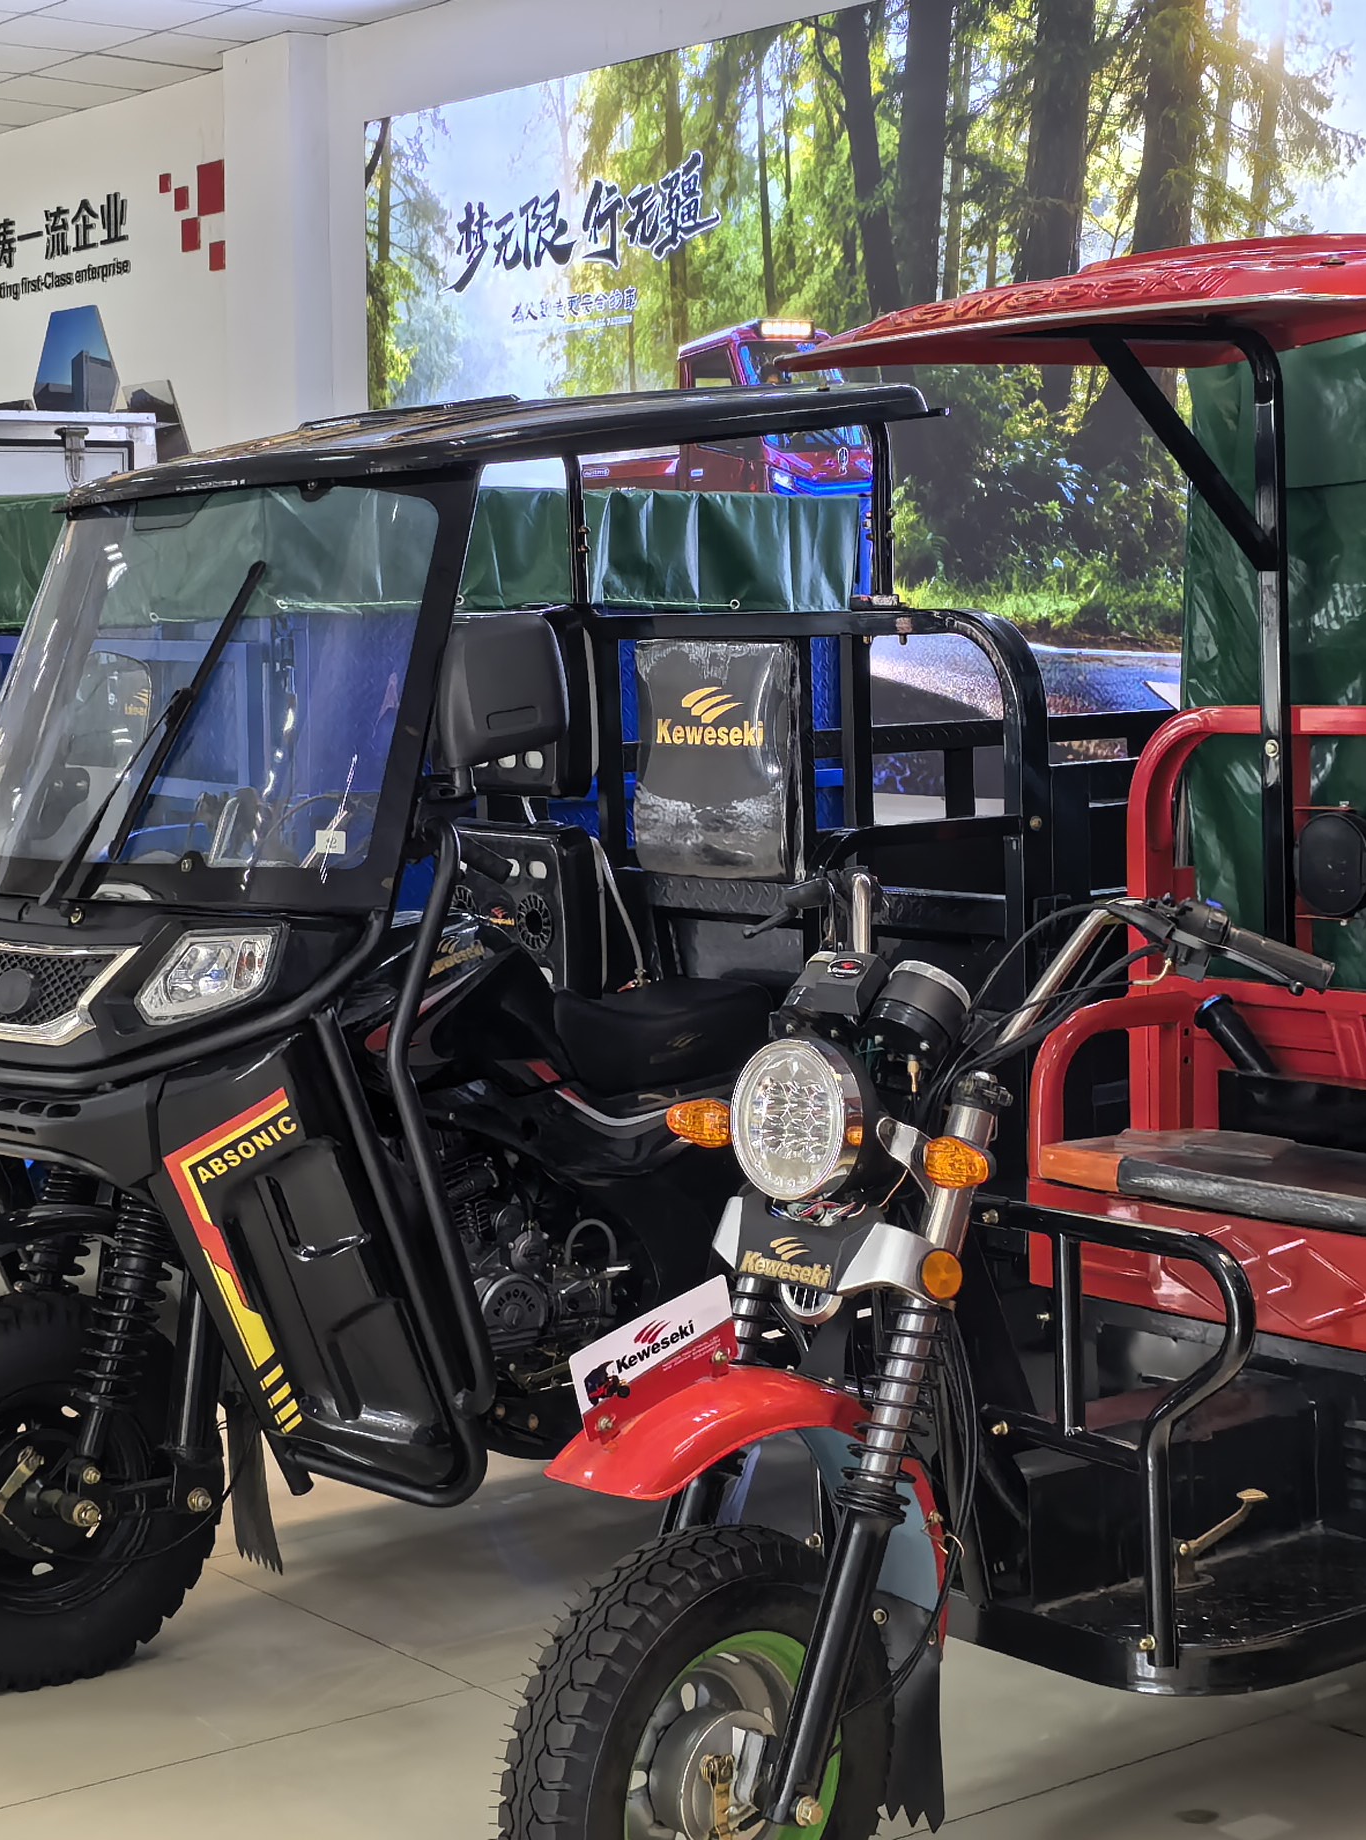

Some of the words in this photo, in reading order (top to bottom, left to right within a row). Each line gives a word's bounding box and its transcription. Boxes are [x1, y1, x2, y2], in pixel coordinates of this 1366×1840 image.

[439, 188, 578, 294] 梦无限
[74, 257, 132, 284] enterprise
[656, 718, 764, 747] Keweseki
[197, 1116, 297, 1184] ABSONIC
[739, 1250, 833, 1289] Keweseki
[615, 1319, 695, 1374] Keweseki
